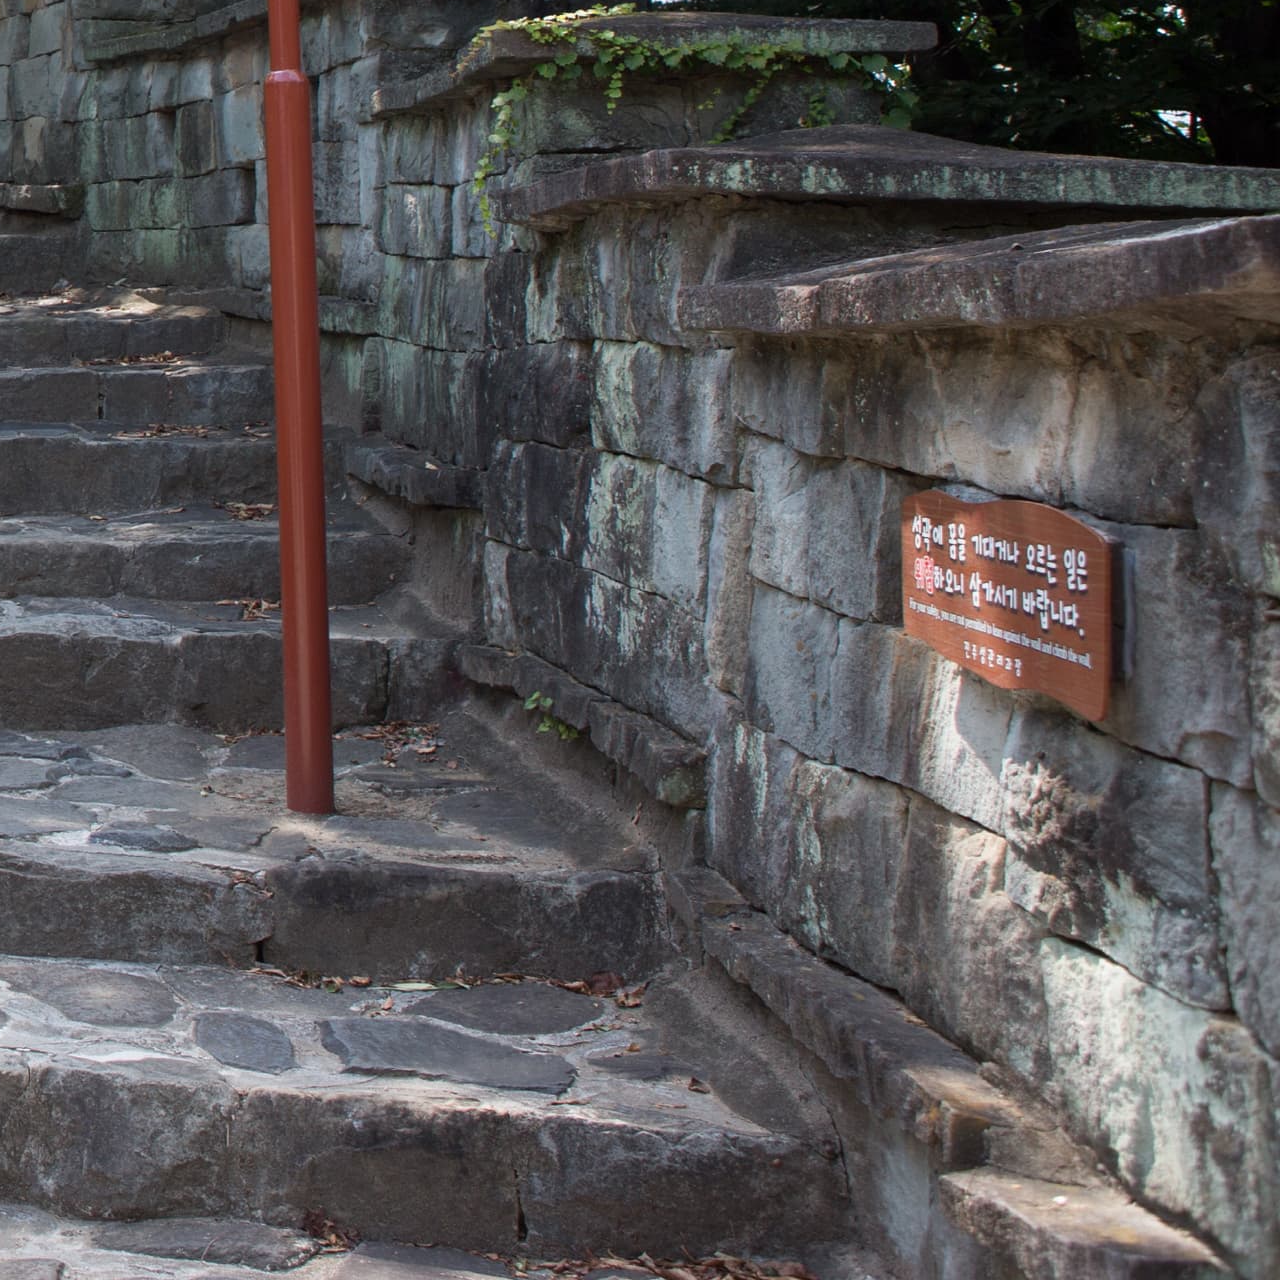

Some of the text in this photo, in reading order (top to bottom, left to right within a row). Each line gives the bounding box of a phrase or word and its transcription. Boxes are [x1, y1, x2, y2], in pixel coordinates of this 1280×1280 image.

[912, 515, 1088, 591] 성곽에 몸을 기대거나 오르는 일은
[914, 555, 1085, 637] 위험하오니 삼가시기 바랍니다.
